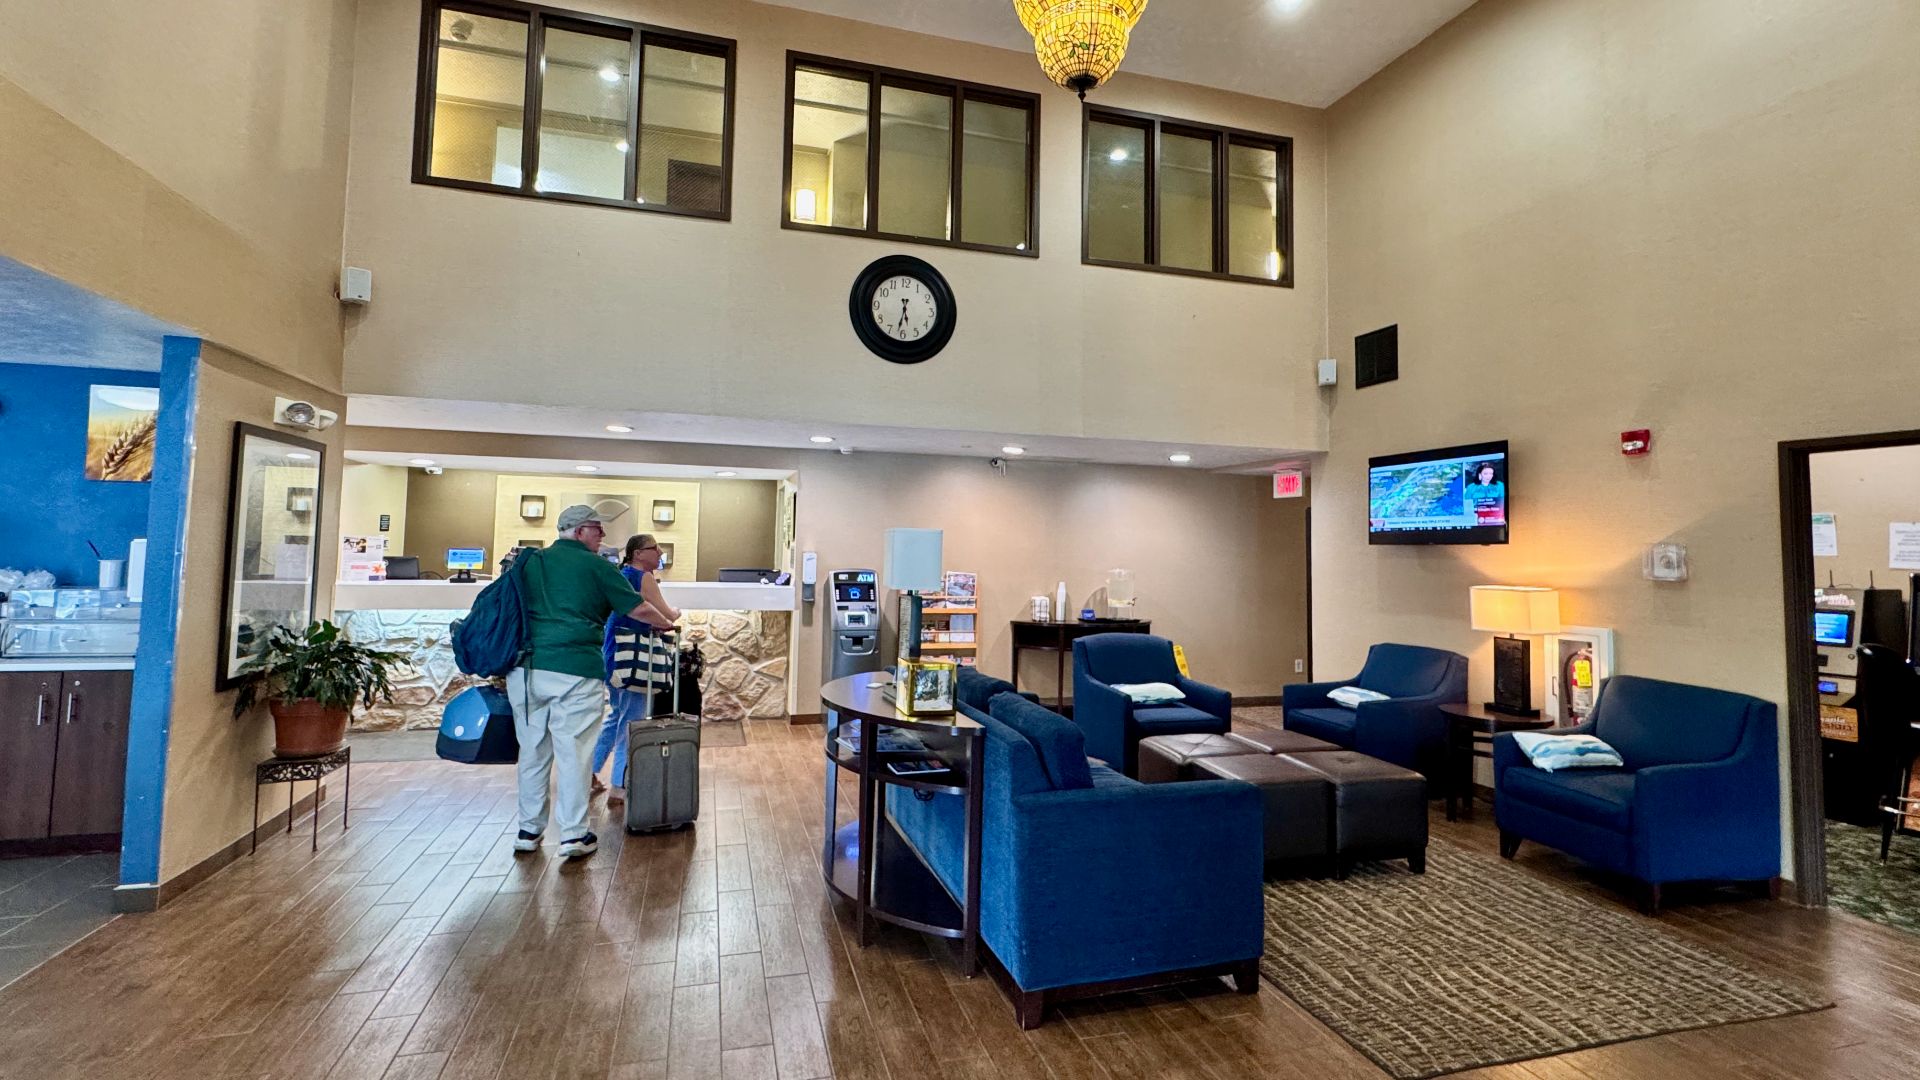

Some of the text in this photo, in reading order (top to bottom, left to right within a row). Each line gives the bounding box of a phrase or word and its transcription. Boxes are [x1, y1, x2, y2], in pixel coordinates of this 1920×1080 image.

[889, 280, 897, 290] 11
[901, 278, 911, 288] 12
[879, 288, 889, 297] 10
[916, 284, 919, 293] 1
[924, 294, 931, 304] 2
[873, 300, 880, 310] 9
[928, 308, 935, 317] 3
[878, 314, 883, 324] 8
[887, 325, 893, 334] 7
[923, 321, 929, 330] 4
[900, 330, 906, 339] 6
[913, 328, 919, 337] 5
[857, 574, 874, 582] ATM
